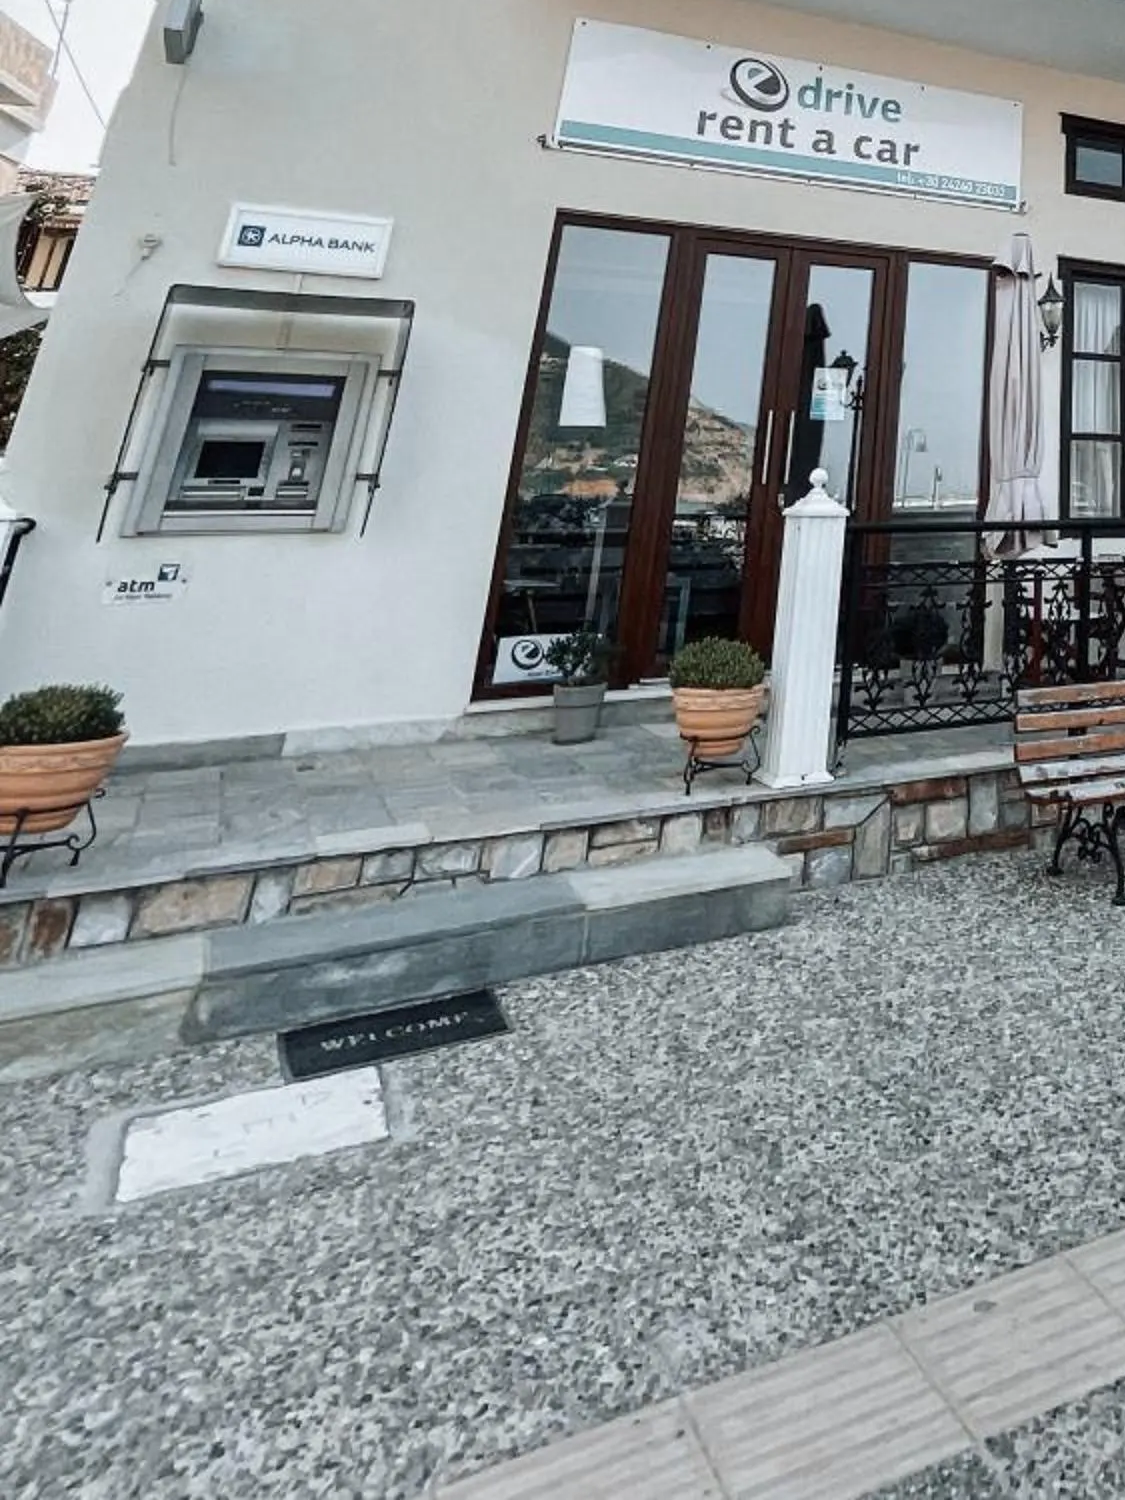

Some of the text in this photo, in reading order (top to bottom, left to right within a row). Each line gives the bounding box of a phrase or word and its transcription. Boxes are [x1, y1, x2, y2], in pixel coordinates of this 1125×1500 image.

[797, 77, 902, 123] drive
[696, 110, 921, 167] rent a car
[267, 233, 375, 254] ALPHA BANK
[117, 580, 156, 593] atm
